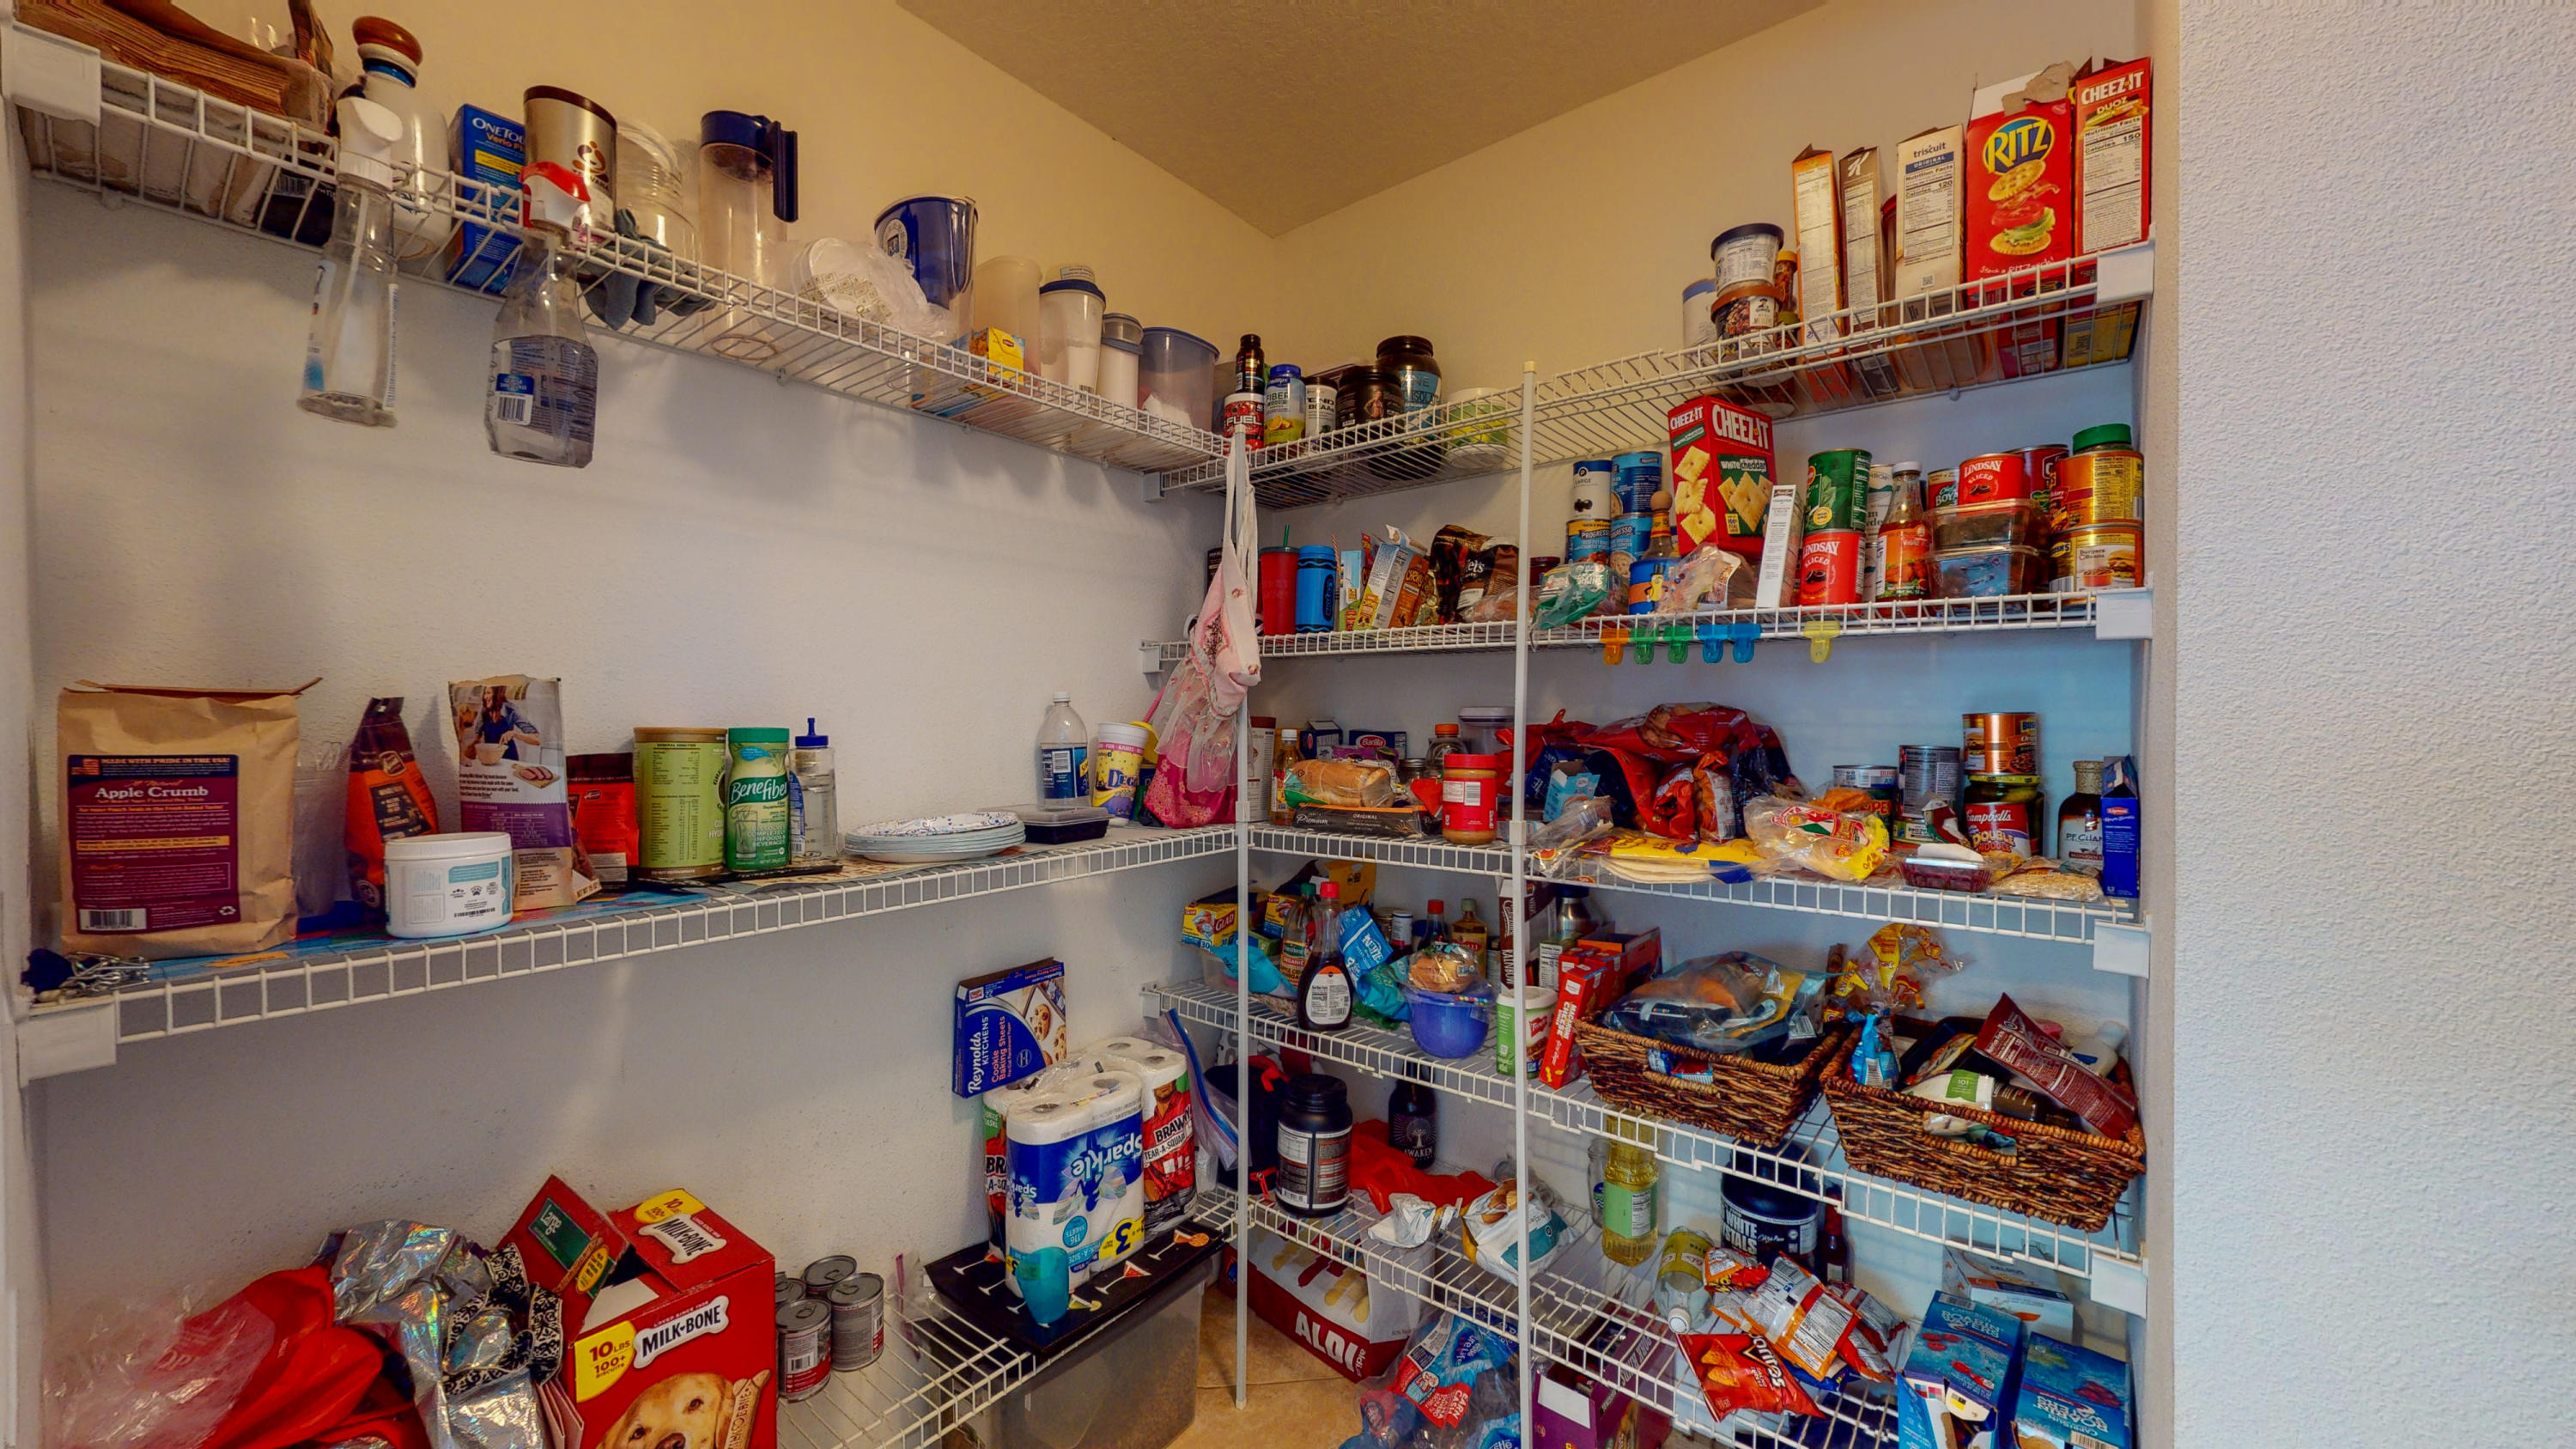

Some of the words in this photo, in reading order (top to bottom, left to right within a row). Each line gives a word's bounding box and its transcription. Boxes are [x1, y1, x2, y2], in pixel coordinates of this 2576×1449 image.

[1913, 141, 1947, 158] triscuit
[1987, 119, 2049, 174] RITZ
[1226, 415, 1262, 427] FUEL
[1669, 405, 1704, 430] CHEEZ-IT
[1711, 404, 1769, 450] CHEEZ-IT
[1741, 458, 1767, 472] cheddar
[1964, 460, 2003, 478] LINDSAY
[1968, 473, 1994, 484] SLICED
[1581, 528, 1611, 539] PROGRESS
[1804, 556, 1831, 569] SLICED
[94, 787, 143, 800] Apple
[148, 786, 209, 797] Crumb
[1297, 814, 1329, 825] Premium
[1352, 813, 1378, 821] ORIGINAL
[1972, 829, 2014, 848] DOUBLE
[1978, 842, 2012, 854] NOODLE
[1215, 913, 1234, 931] GLAD
[998, 1016, 1006, 1048] Sheets
[968, 1032, 983, 1093] Reynolds
[991, 1050, 999, 1083] Cookie
[998, 1050, 1008, 1083] Baking
[1071, 1133, 1143, 1179] Sparkle
[1403, 1147, 1432, 1157] AWAKEN
[664, 1197, 683, 1209] 10
[540, 1206, 563, 1237] Large
[1725, 1209, 1757, 1239] WHITE
[653, 1216, 714, 1257] MILK-BONE
[1115, 1223, 1133, 1255] 3
[1723, 1226, 1757, 1255] STALS
[641, 1304, 721, 1359] MILK-BONE
[589, 1341, 614, 1362] 10
[613, 1340, 630, 1354] LBS
[1295, 1311, 1358, 1373] ALDI
[593, 1355, 627, 1374] 100+
[596, 1362, 625, 1379] BISCUITS
